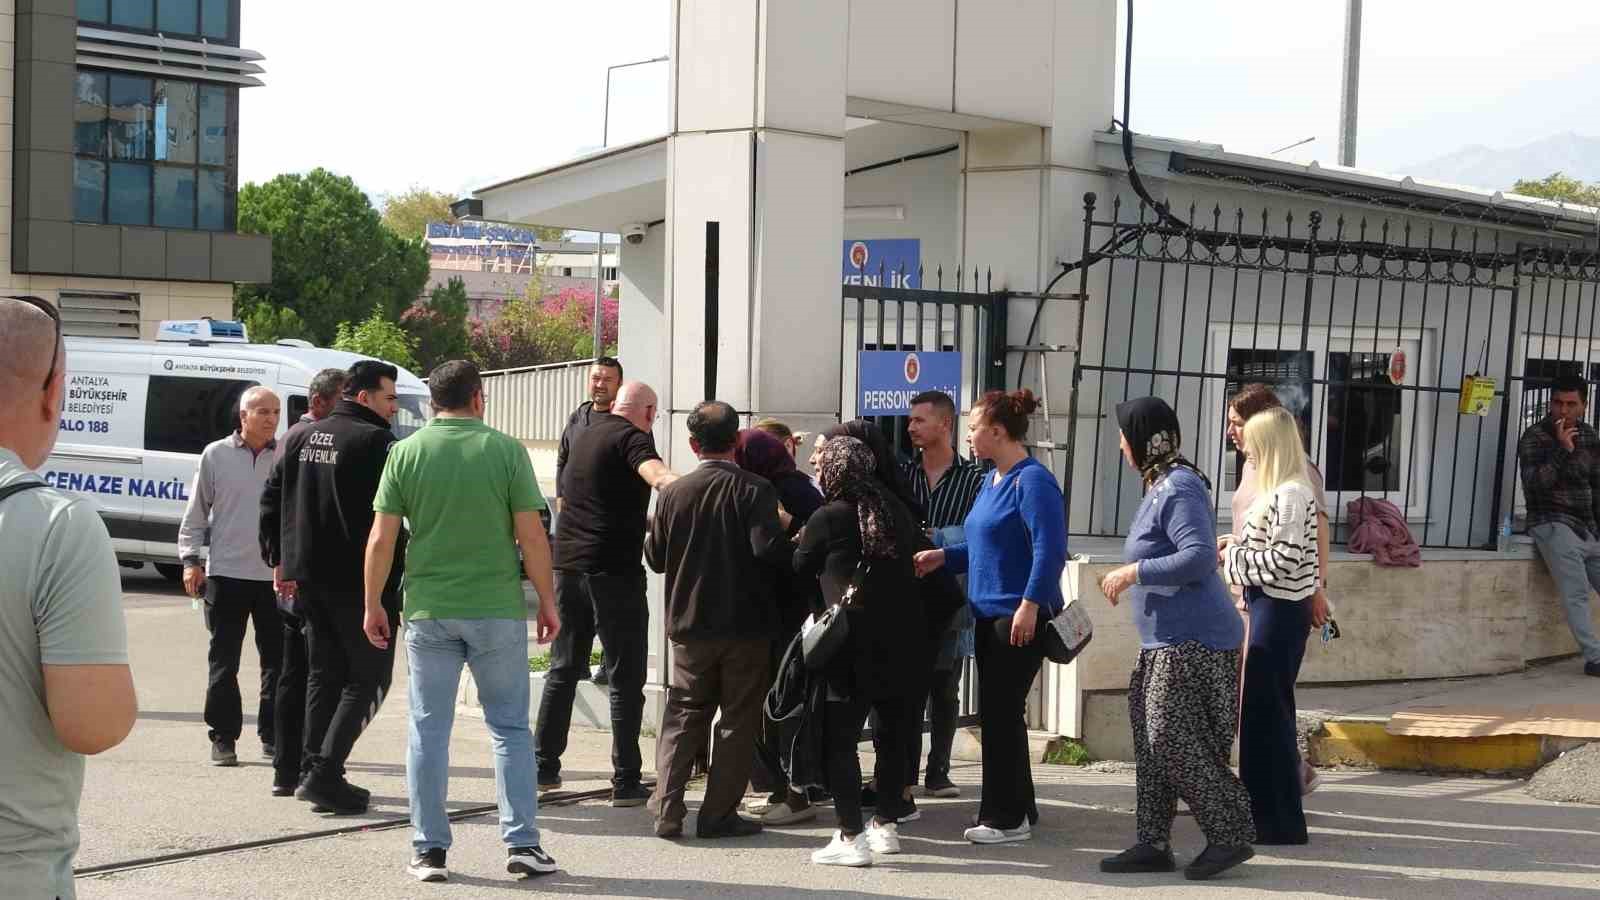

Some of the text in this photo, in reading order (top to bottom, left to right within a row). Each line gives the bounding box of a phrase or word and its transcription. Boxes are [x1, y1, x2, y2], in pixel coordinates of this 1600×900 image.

[71, 376, 109, 386] ANTALYA
[69, 387, 128, 402] BÜYÜKŞEHİR
[864, 390, 920, 410] PERSONE
[68, 402, 114, 415] BELEDİYESİ
[59, 419, 109, 433] ALO 188
[310, 431, 335, 446] ÖZEL
[44, 471, 189, 501] CENAZE NAKİL
